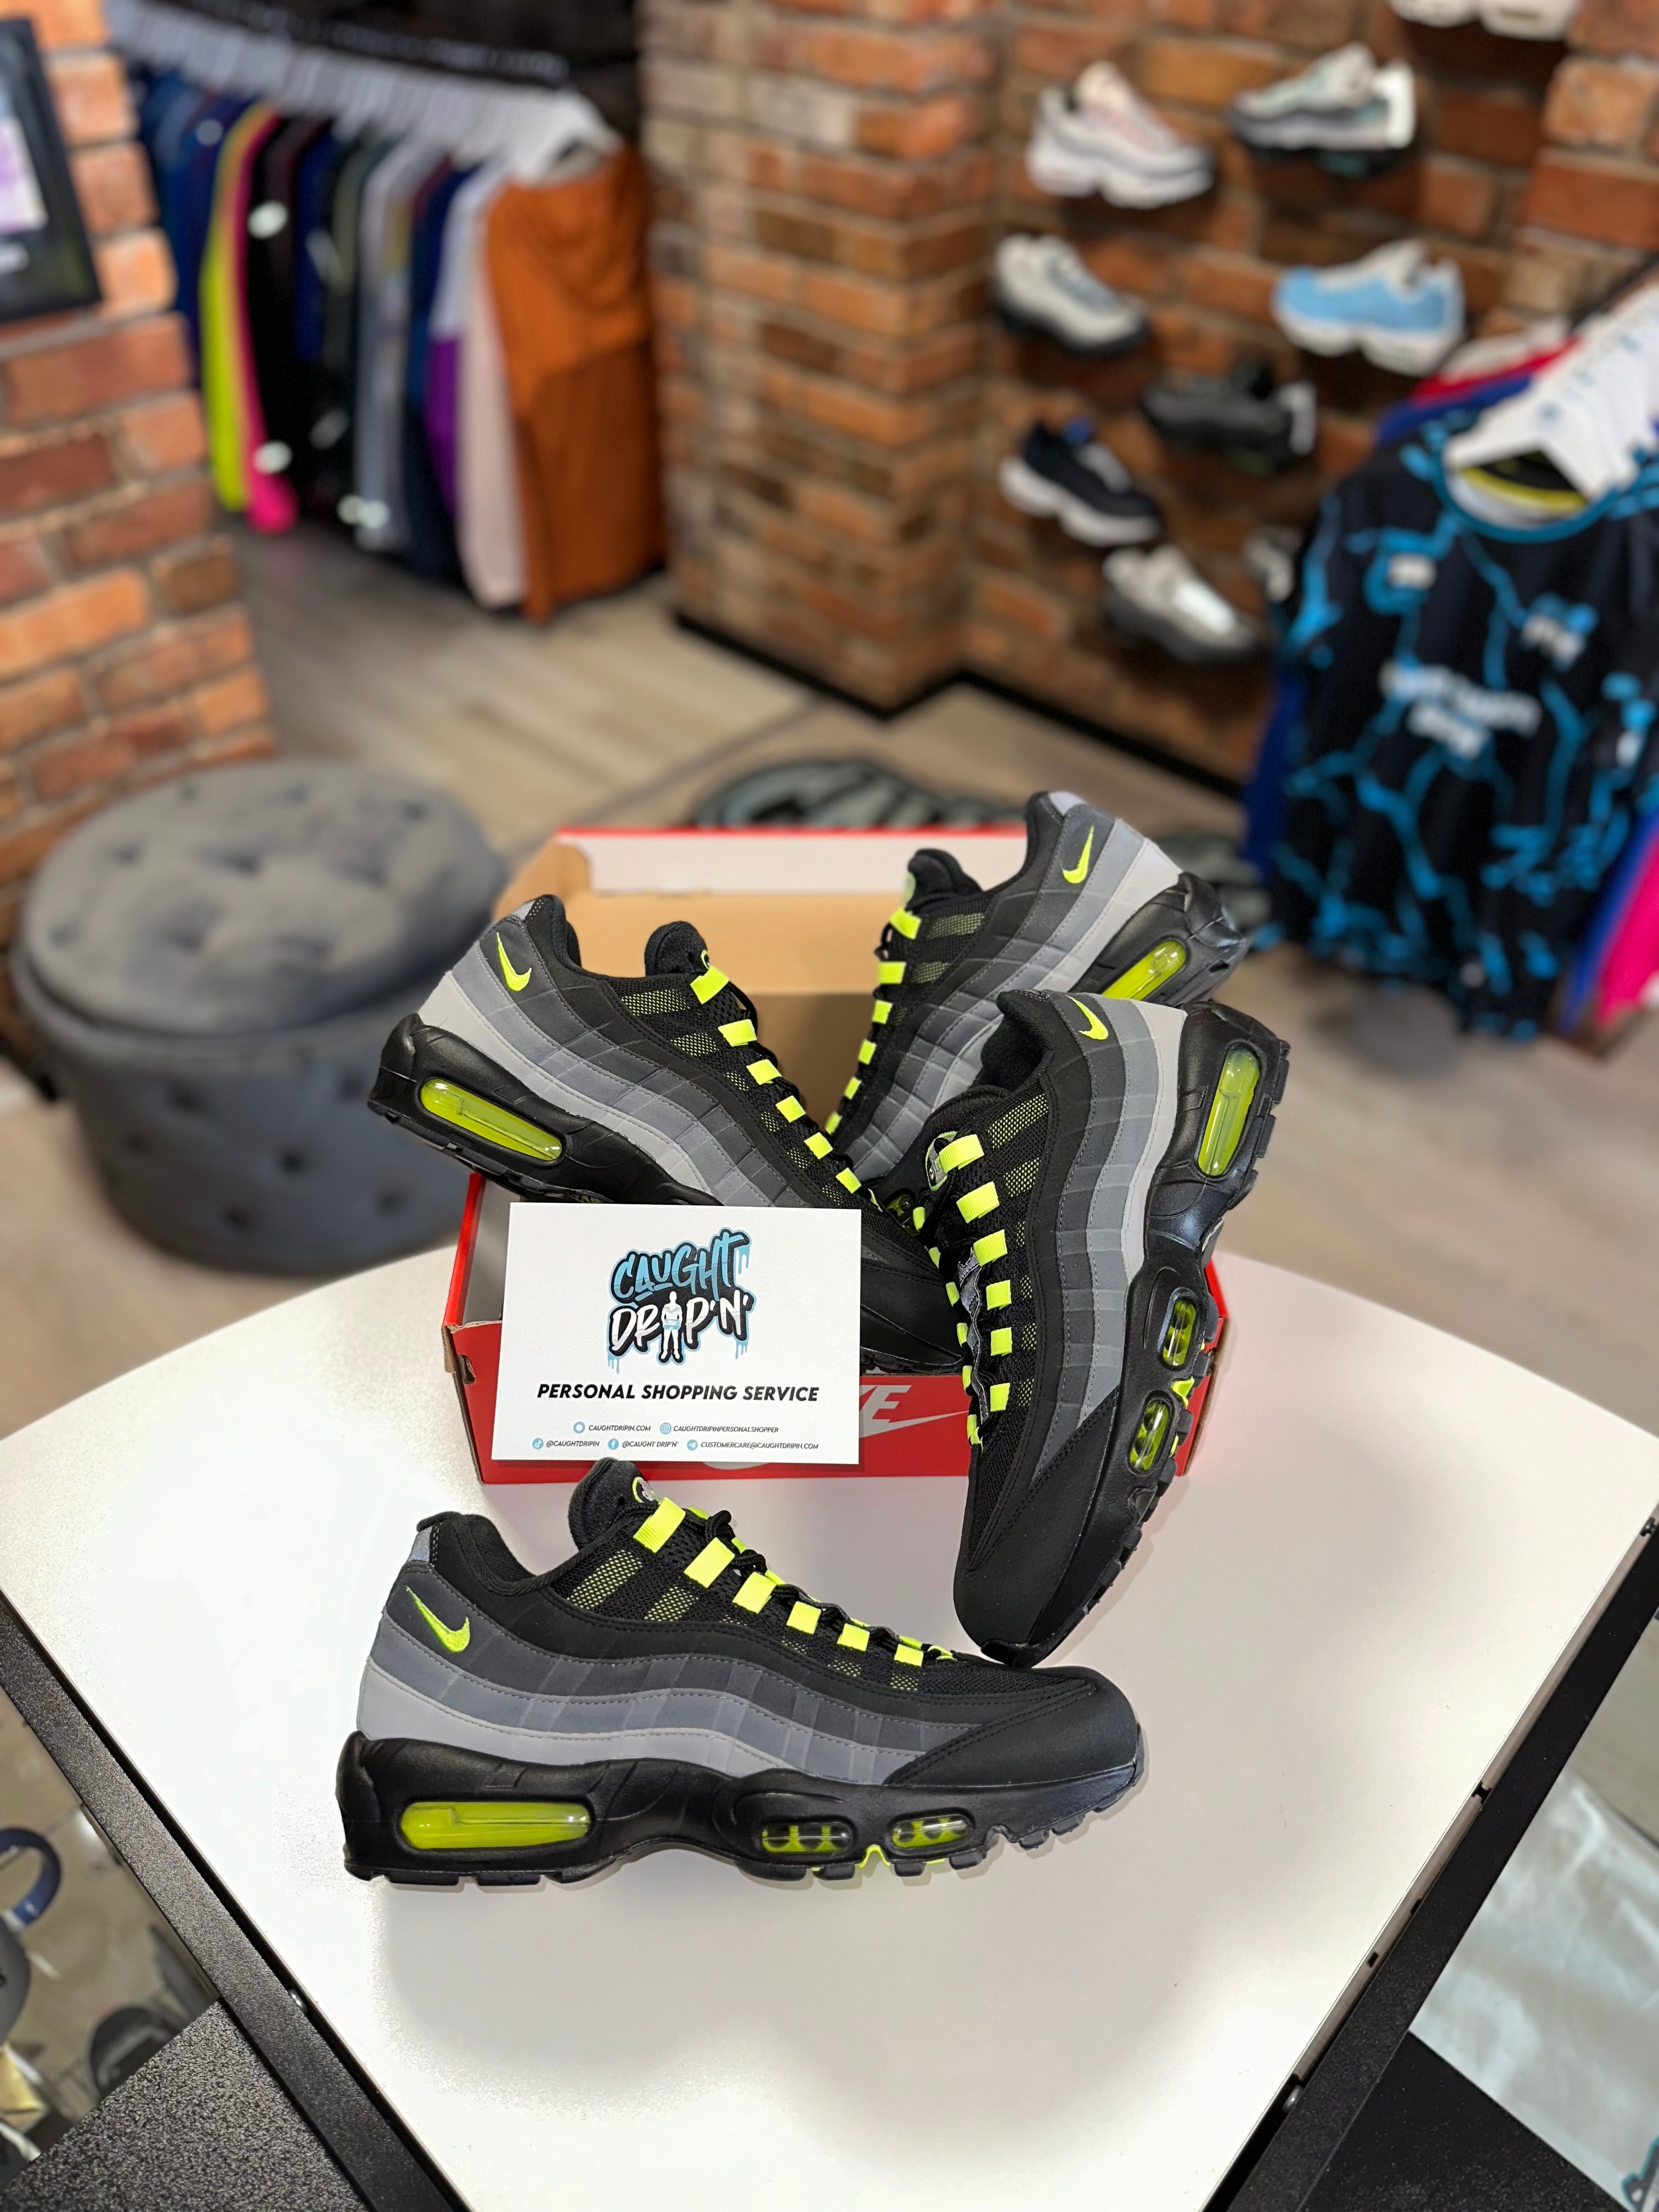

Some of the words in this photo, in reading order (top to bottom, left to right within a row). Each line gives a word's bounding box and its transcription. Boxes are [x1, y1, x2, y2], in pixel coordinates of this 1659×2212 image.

[613, 1231, 744, 1302] CAUGHT
[537, 1384, 635, 1399] PERSONAL
[641, 1384, 737, 1400] SHOPPING
[742, 1385, 820, 1402] SERVICE
